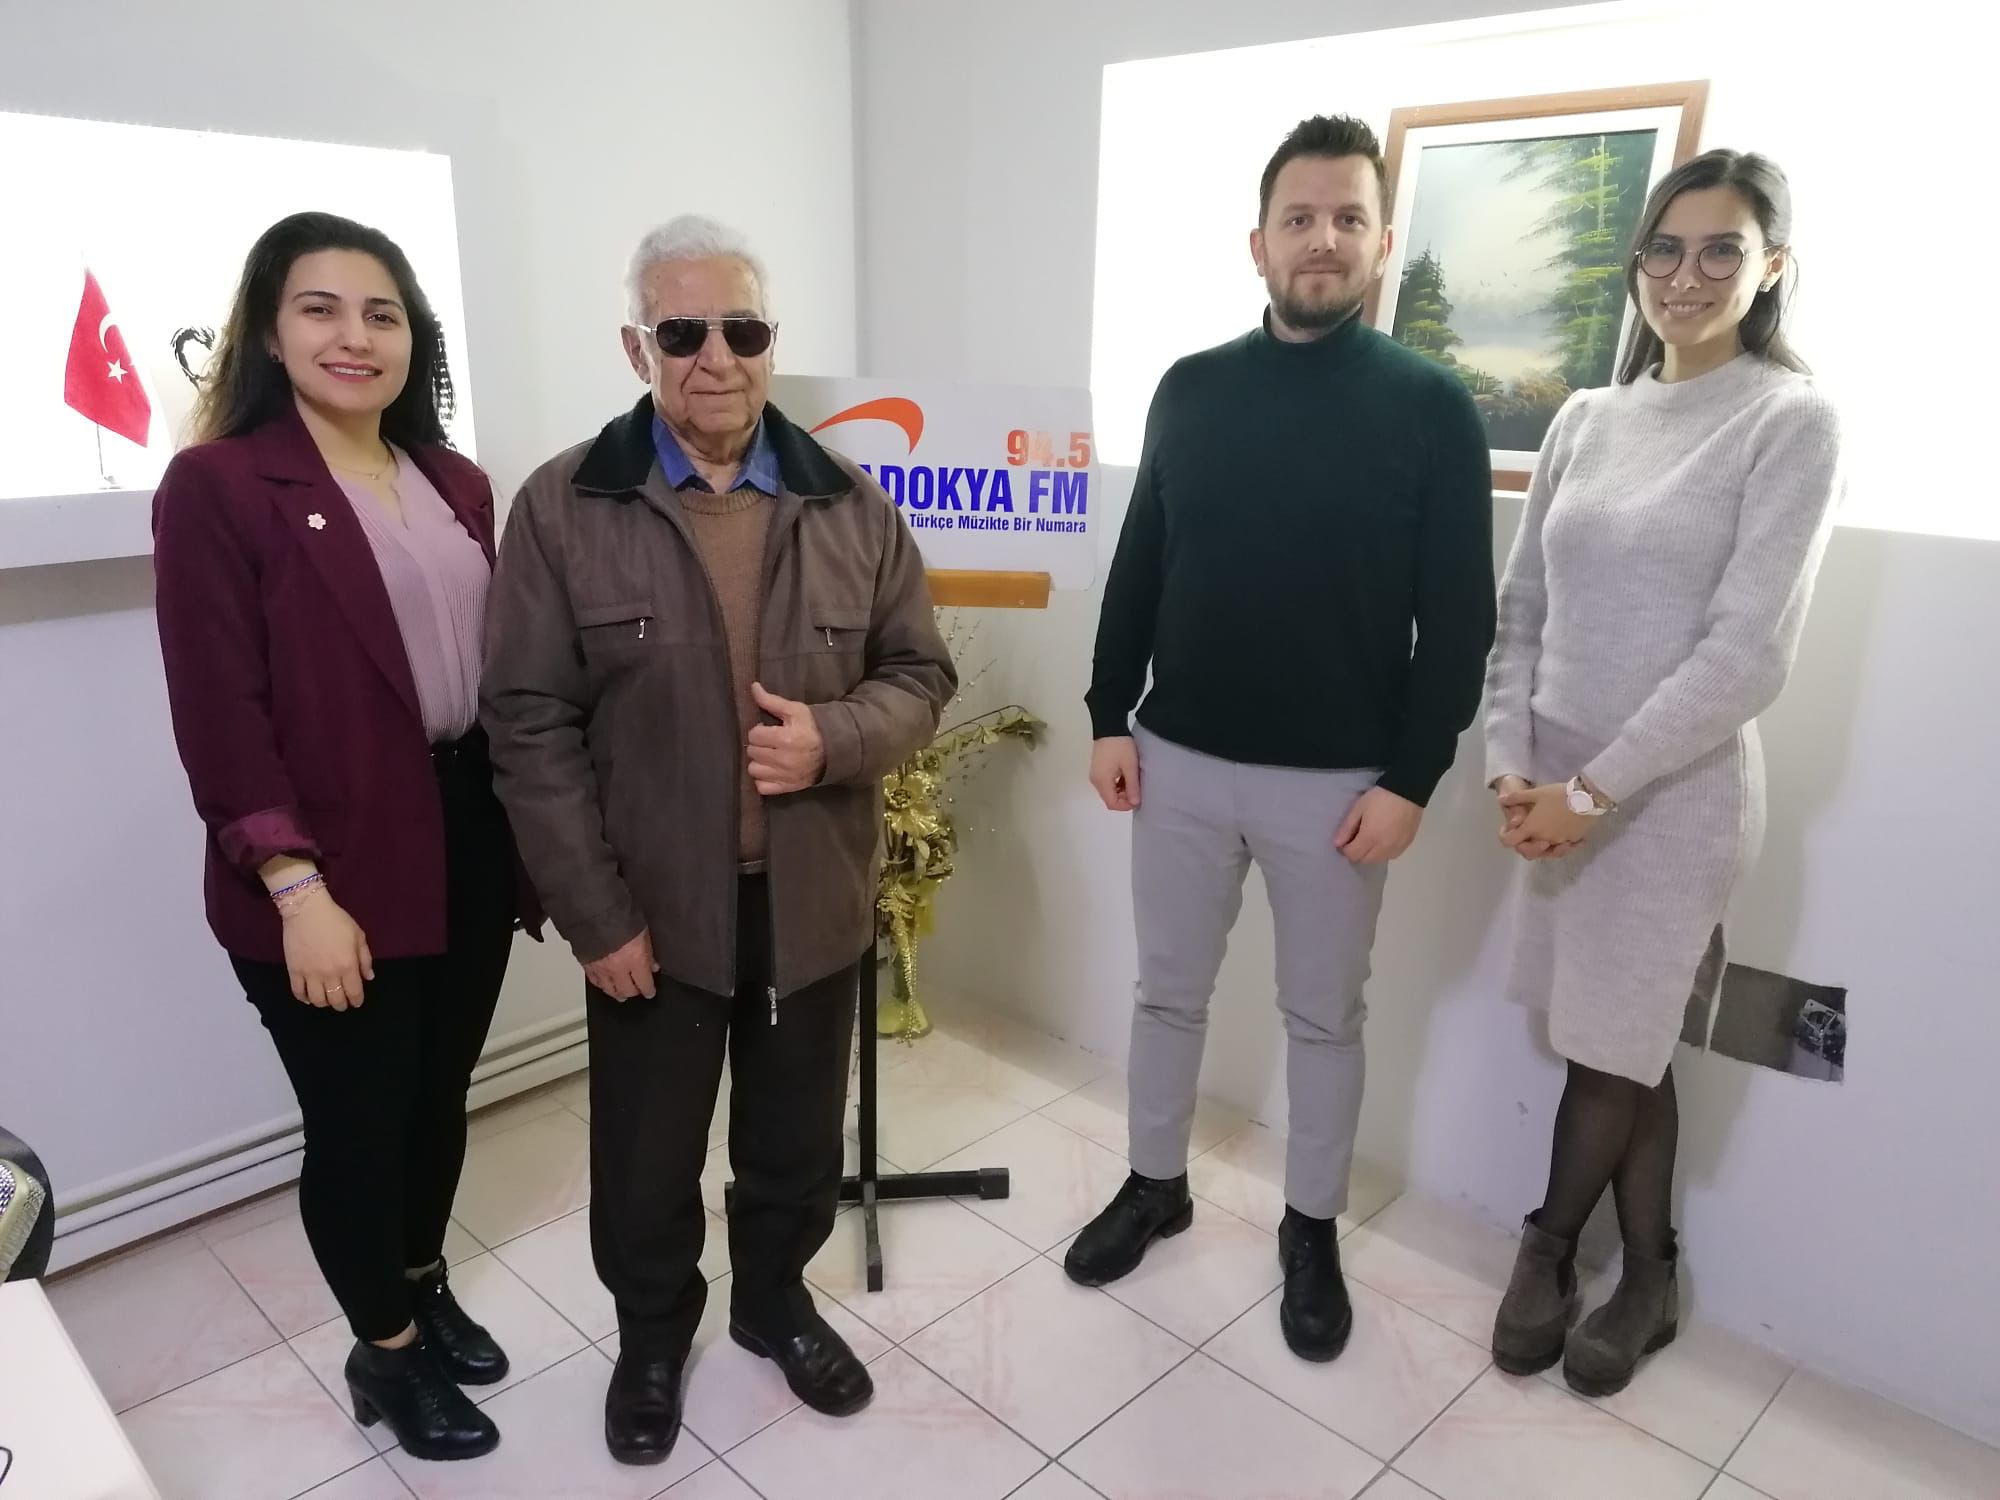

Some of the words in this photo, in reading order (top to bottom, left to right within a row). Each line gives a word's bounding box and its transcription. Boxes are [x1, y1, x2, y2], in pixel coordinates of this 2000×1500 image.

[859, 464, 1014, 512] DOKYA
[1029, 470, 1088, 514] FM
[909, 513, 953, 531] Türkçe
[958, 515, 1009, 531] Müzikte
[1013, 517, 1032, 531] Bir
[1036, 518, 1086, 533] Numara
